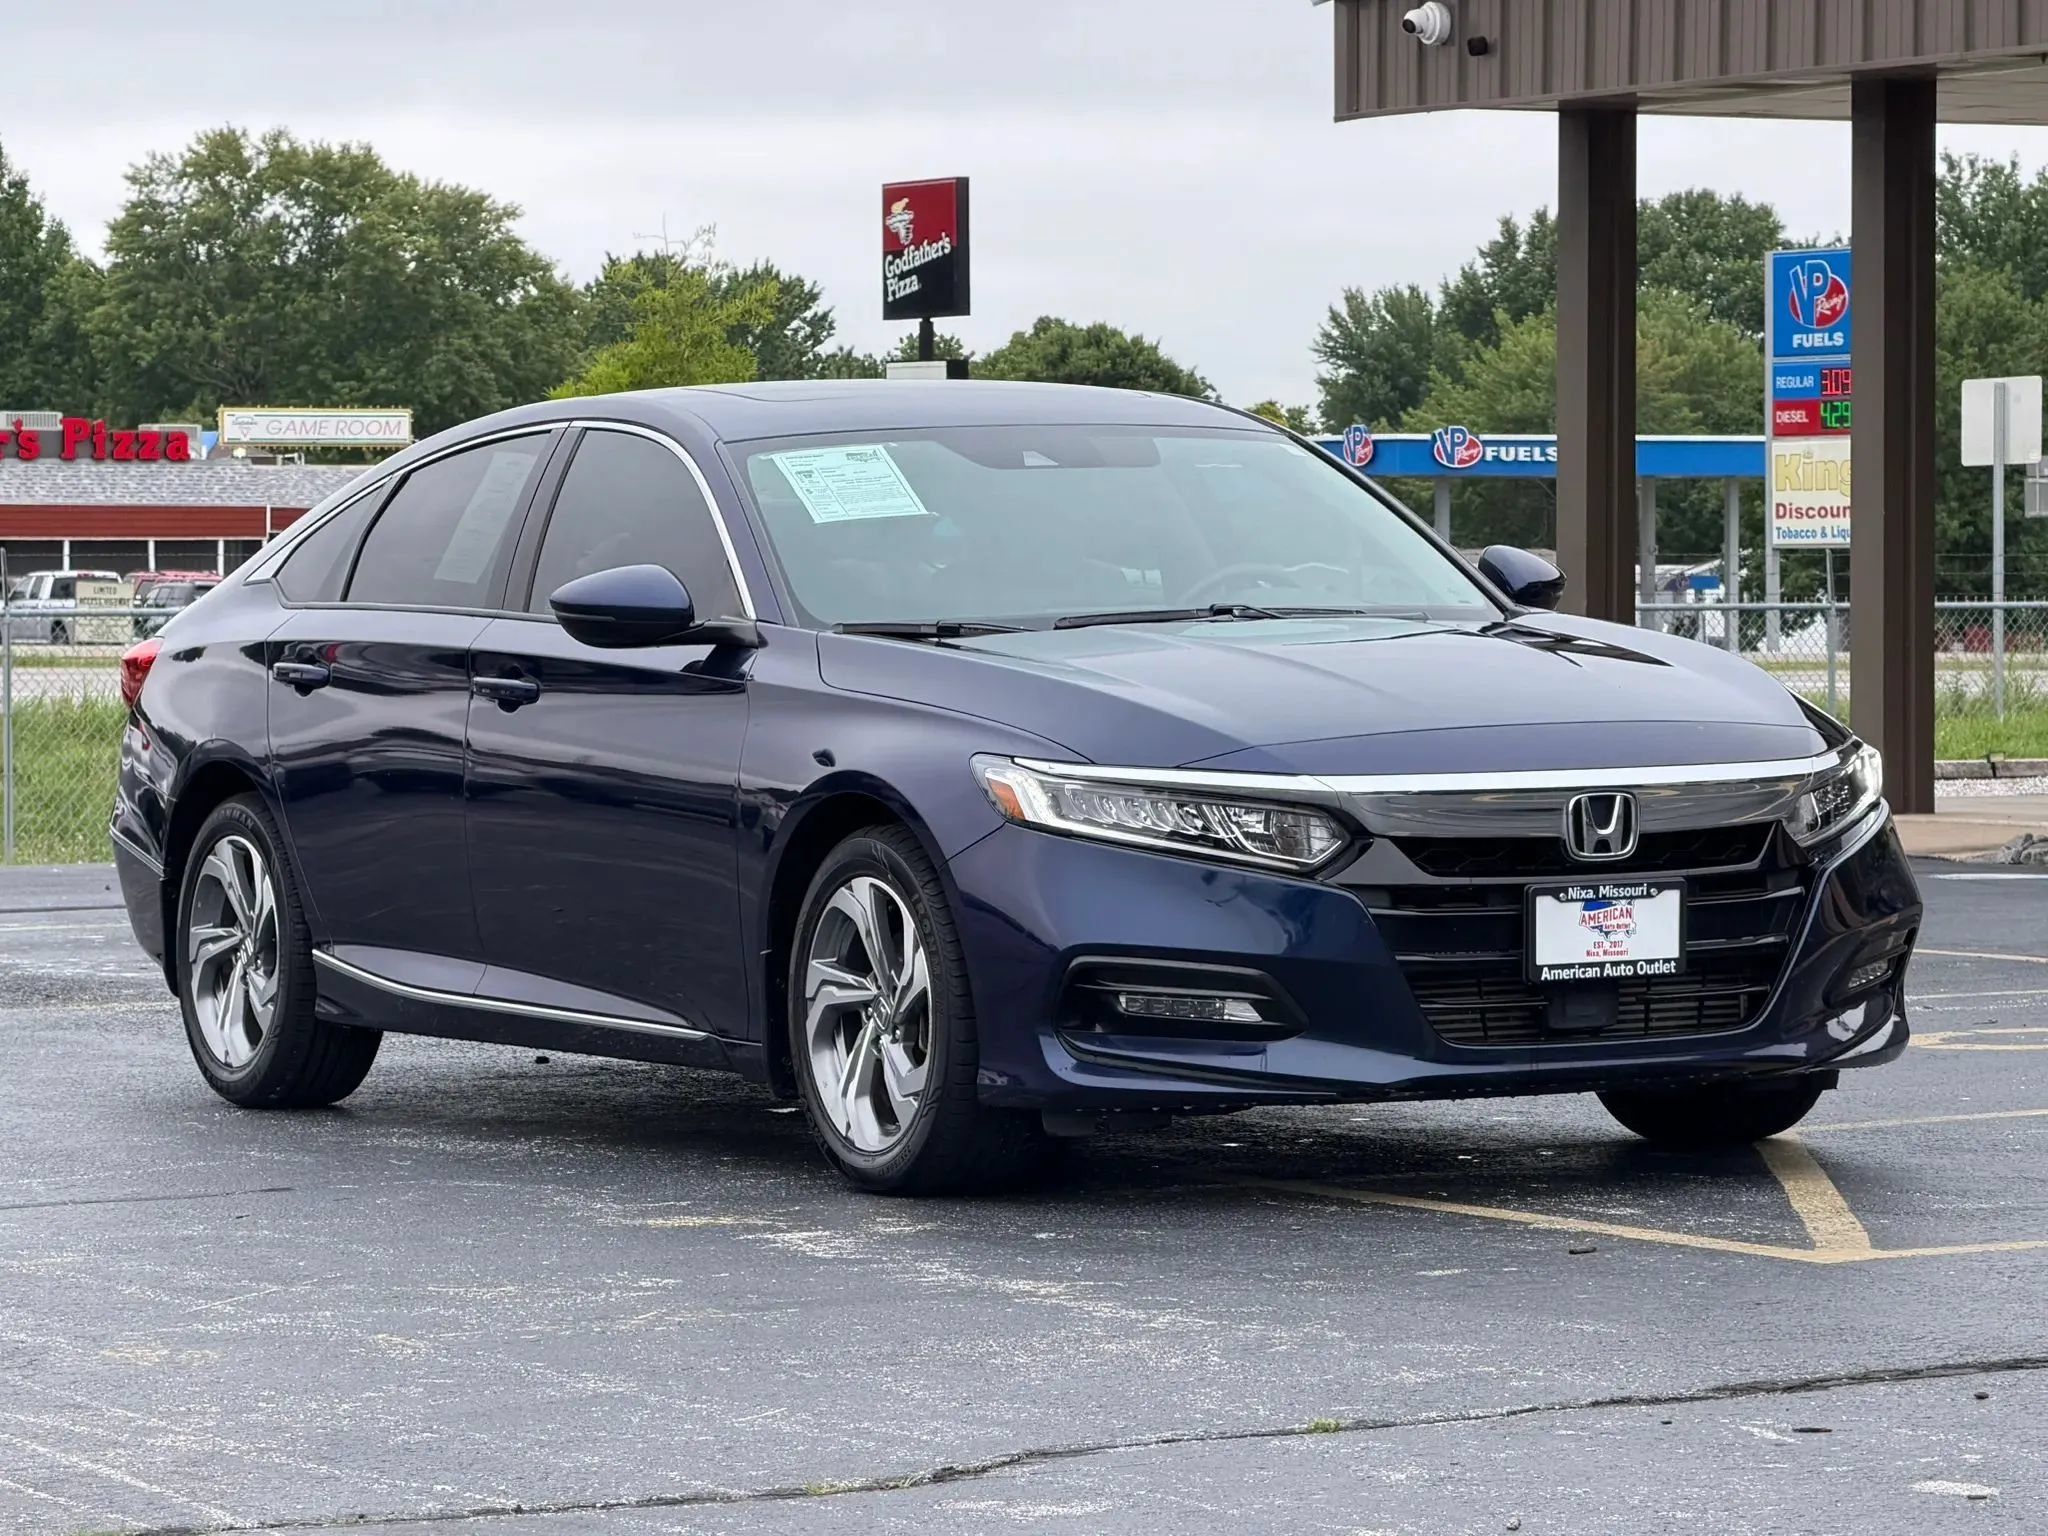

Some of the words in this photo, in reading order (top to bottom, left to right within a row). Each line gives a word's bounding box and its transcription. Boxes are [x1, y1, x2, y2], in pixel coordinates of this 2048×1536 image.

[885, 232, 951, 277] Godfather's
[886, 274, 919, 302] Pizza
[1792, 332, 1844, 348] FUELS
[1776, 376, 1814, 388] REGULAR
[1776, 410, 1808, 423] DIESEL
[266, 419, 329, 436] GAME
[335, 419, 402, 436] ROOM
[60, 416, 191, 460] Pizza
[1485, 446, 1557, 462] FUELS
[1776, 526, 1817, 539] Tobacco
[1820, 526, 1828, 538] &
[1568, 887, 1596, 899] Nixa,
[1599, 883, 1648, 898] Missouri
[1580, 906, 1633, 926] AMERICAN
[1593, 941, 1606, 949] EST.
[1609, 940, 1624, 948] 2017
[1541, 966, 1600, 981] American
[1603, 962, 1634, 977] Auto
[1636, 959, 1676, 976] Outlet
